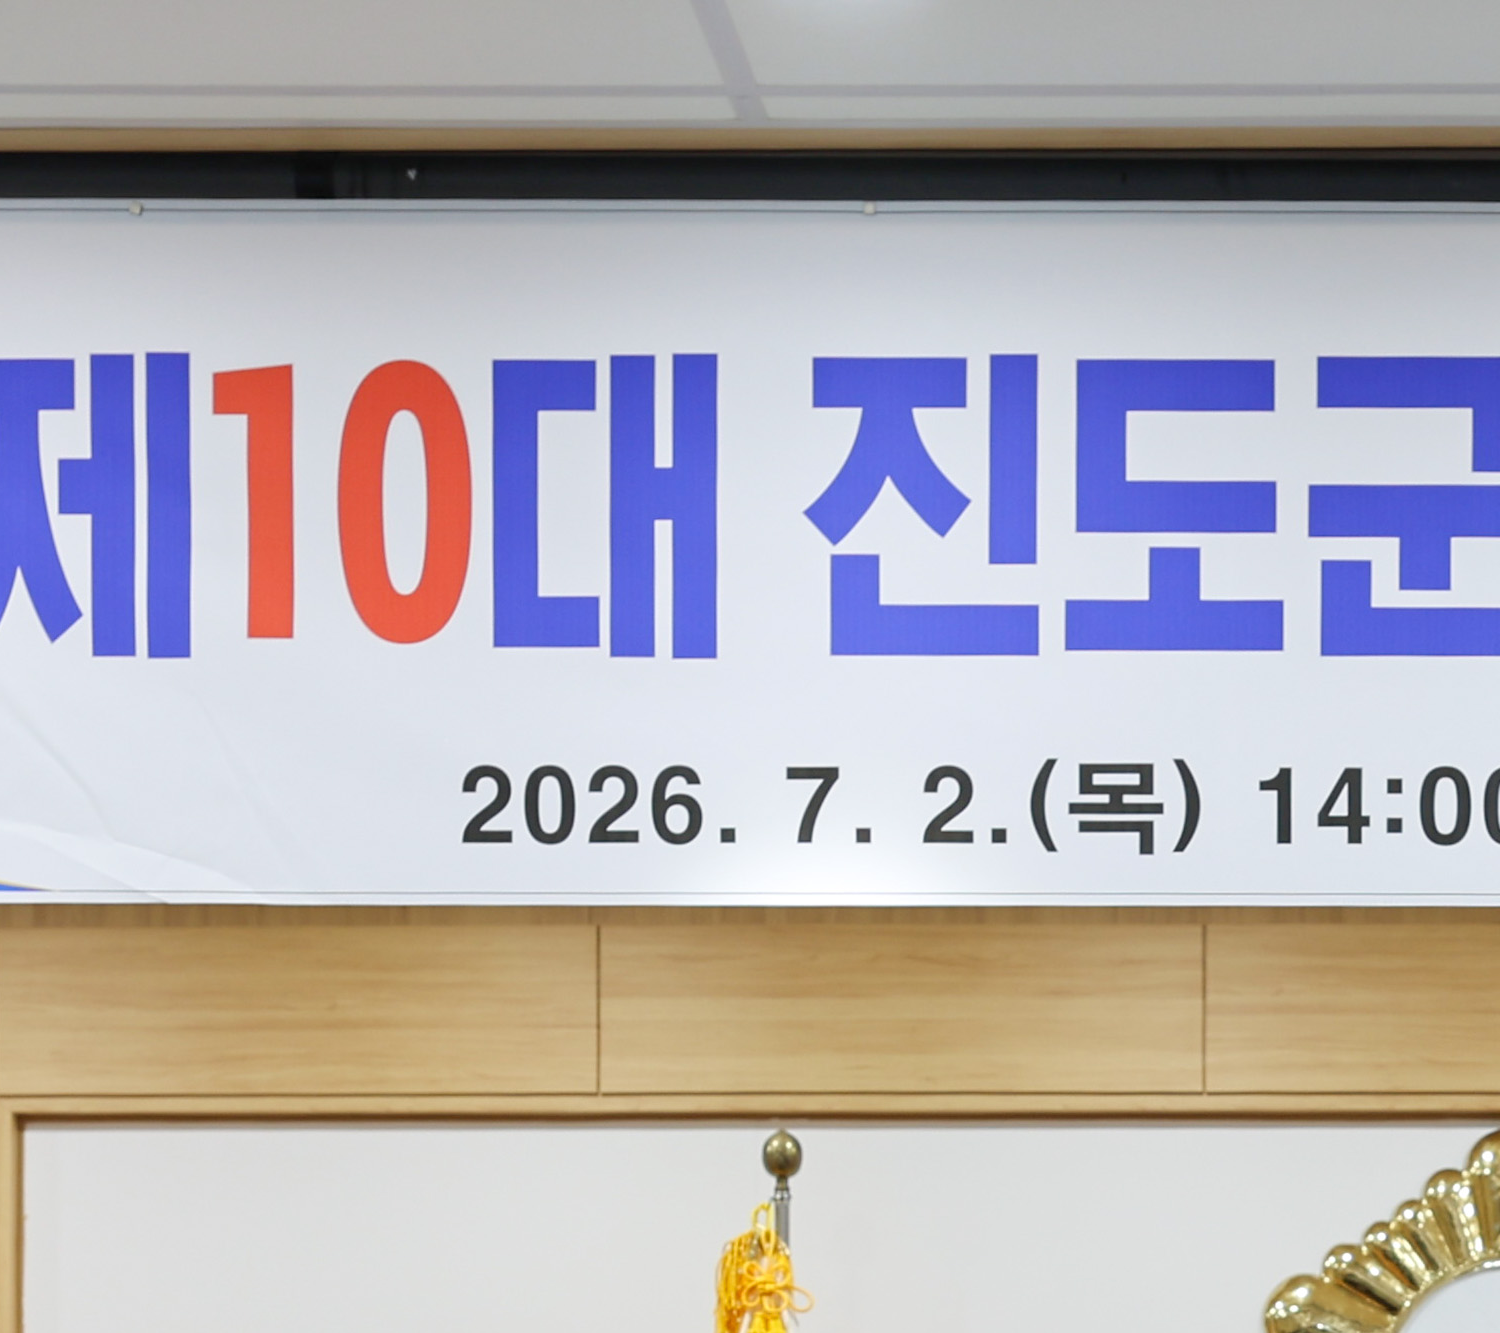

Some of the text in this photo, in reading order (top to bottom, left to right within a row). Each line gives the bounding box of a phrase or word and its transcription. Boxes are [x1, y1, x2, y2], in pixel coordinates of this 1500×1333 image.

[459, 764, 741, 850] 2026.
[783, 766, 874, 850] 7.
[922, 756, 1206, 858] 2.(목)
